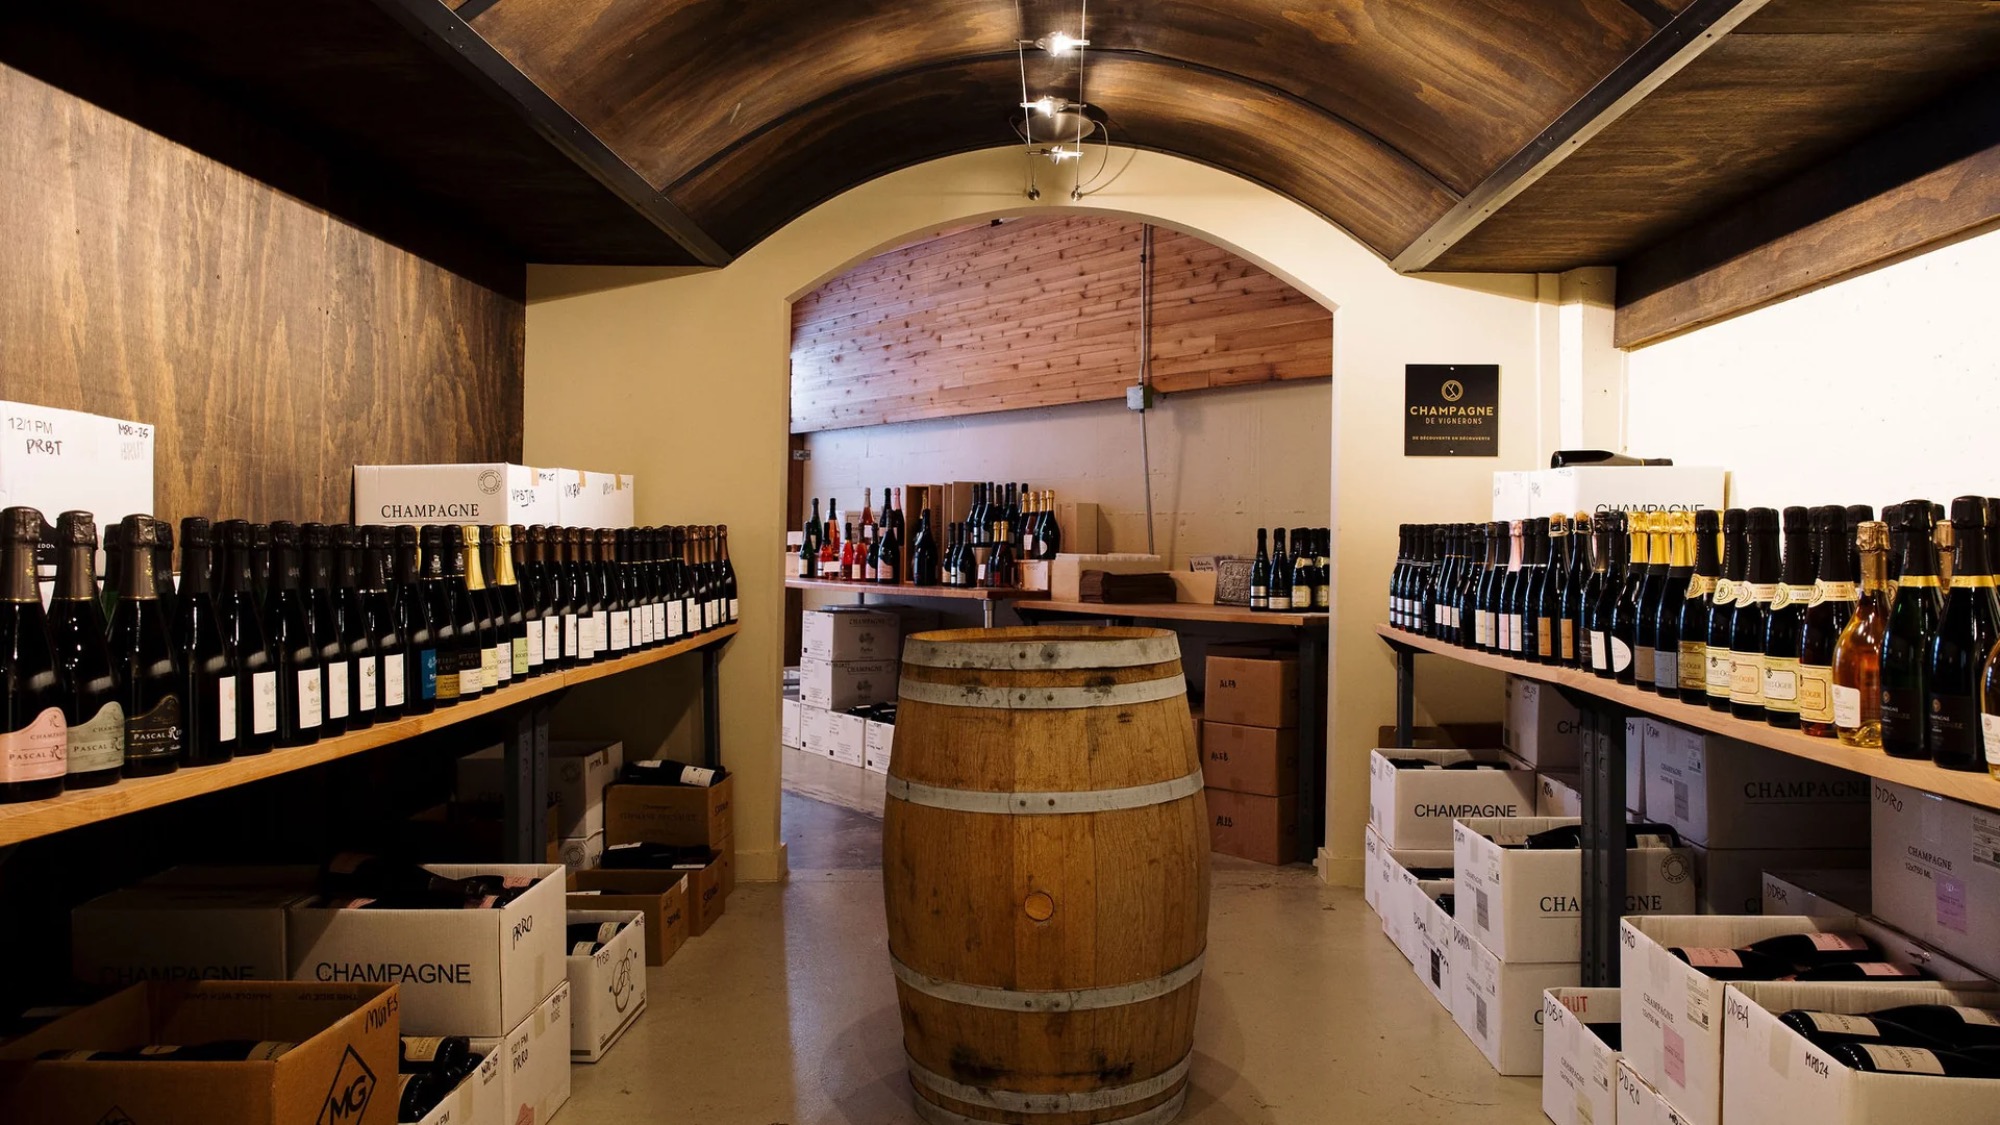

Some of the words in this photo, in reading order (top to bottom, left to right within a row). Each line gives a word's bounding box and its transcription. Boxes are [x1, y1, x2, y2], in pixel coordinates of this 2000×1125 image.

[1410, 406, 1494, 416] CHAMPAGNE
[35, 420, 53, 435] PM
[1425, 417, 1435, 425] DE
[1438, 417, 1483, 425] VIGNERONS
[26, 438, 63, 455] PRBT
[381, 503, 480, 519] CHAMPAGNE
[133, 732, 166, 741] PASCAL
[9, 752, 47, 761] PASCAL
[1744, 782, 1871, 799] CHAMPAGNE
[1414, 804, 1517, 818] CHAMPAGNE
[1907, 845, 1953, 871] CHAMPAGNE
[1540, 896, 1662, 912] CHAGNE
[315, 962, 472, 984] CHAMPAGNE
[1643, 992, 1674, 1024] CHAMPAGNE
[330, 1074, 367, 1125] MG
